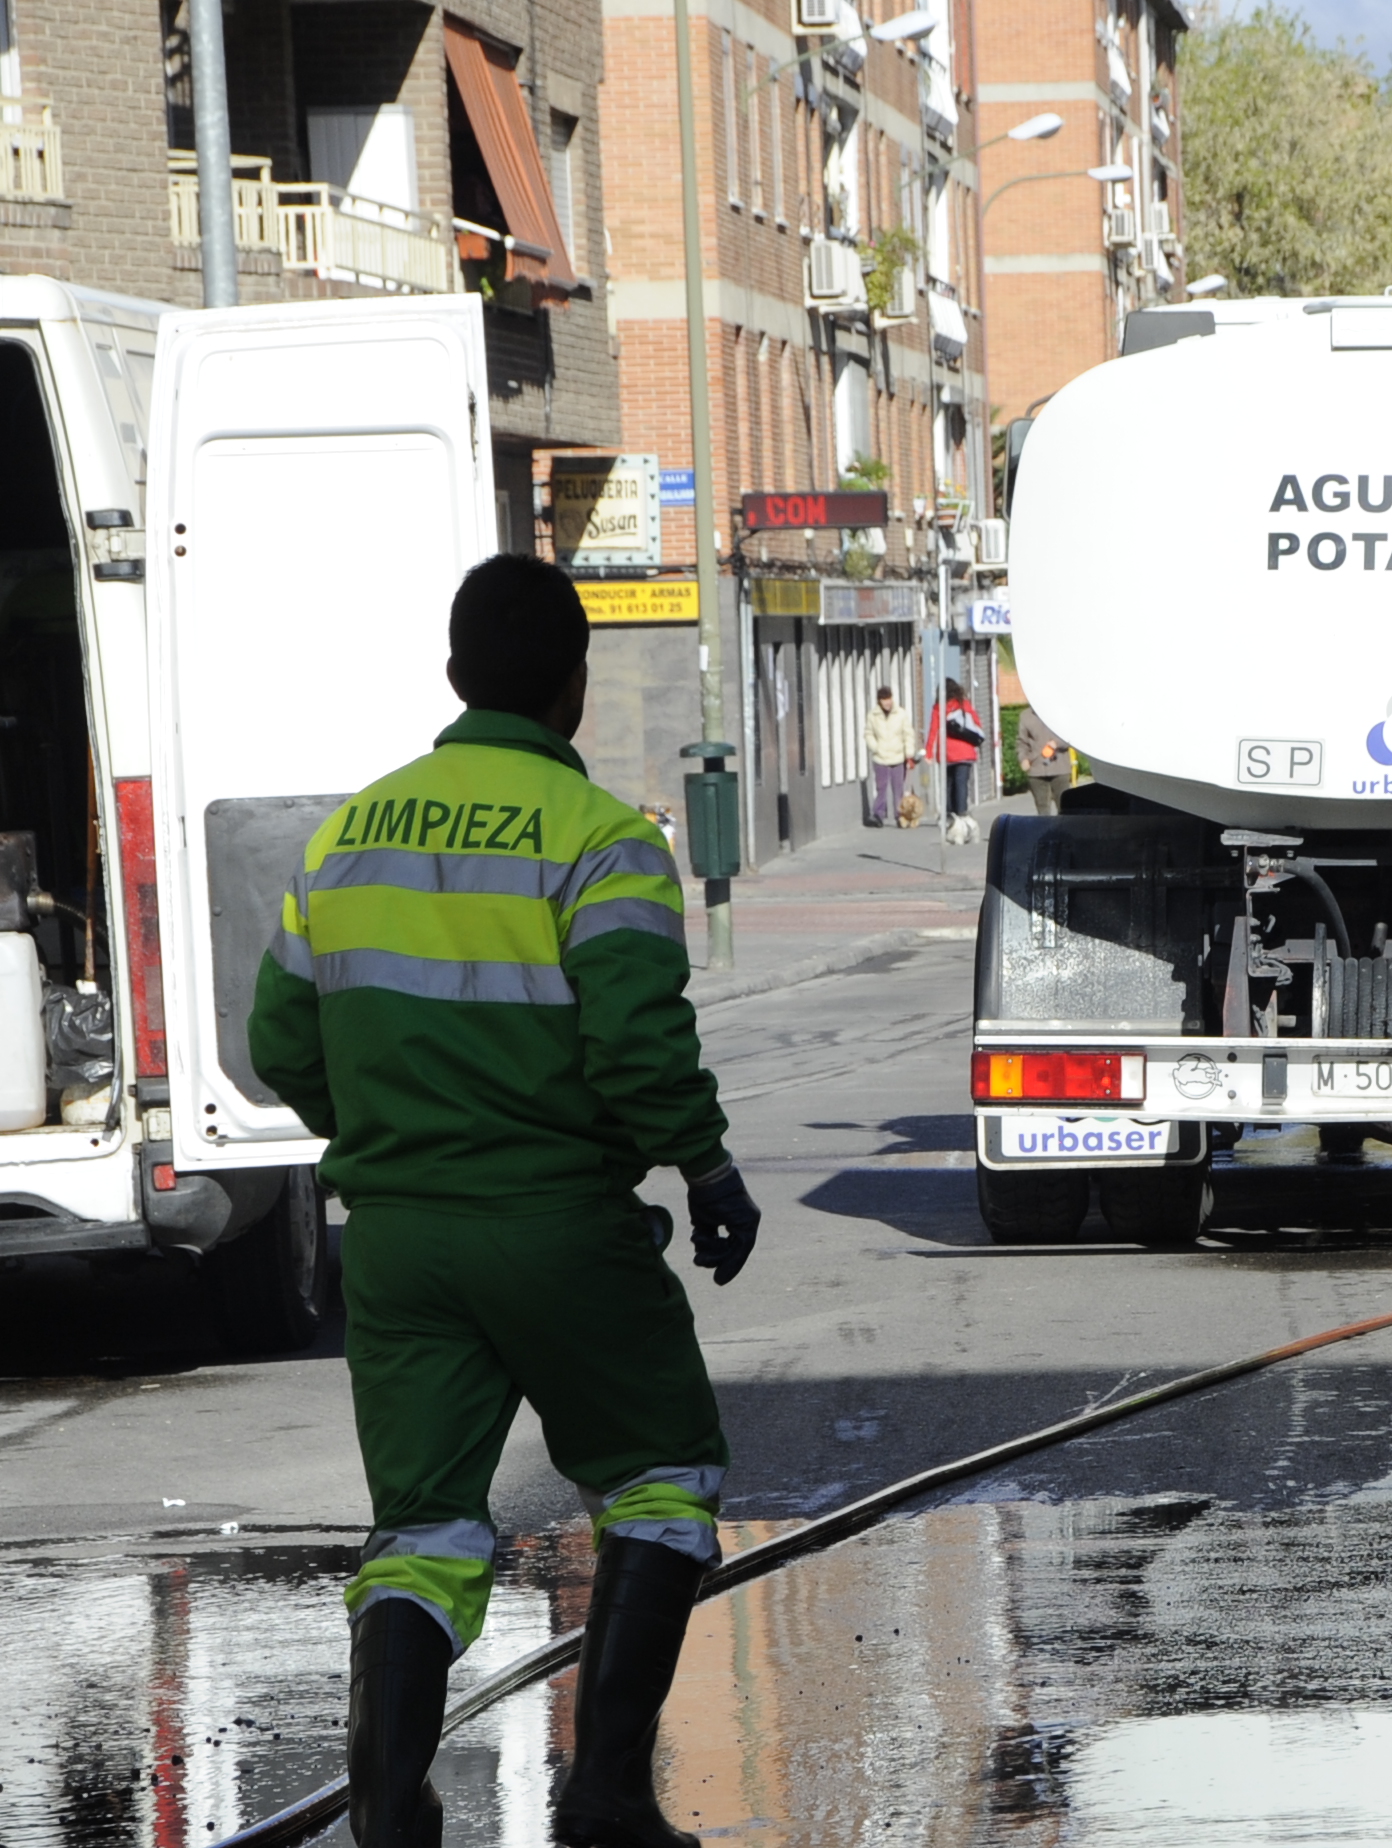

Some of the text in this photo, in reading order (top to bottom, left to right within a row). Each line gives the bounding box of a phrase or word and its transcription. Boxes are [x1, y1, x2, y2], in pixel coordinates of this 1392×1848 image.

[587, 507, 638, 539] Susan
[650, 587, 691, 598] ARMAS
[336, 798, 542, 854] LIMPIEZA
[1018, 1125, 1162, 1153] urbaser
